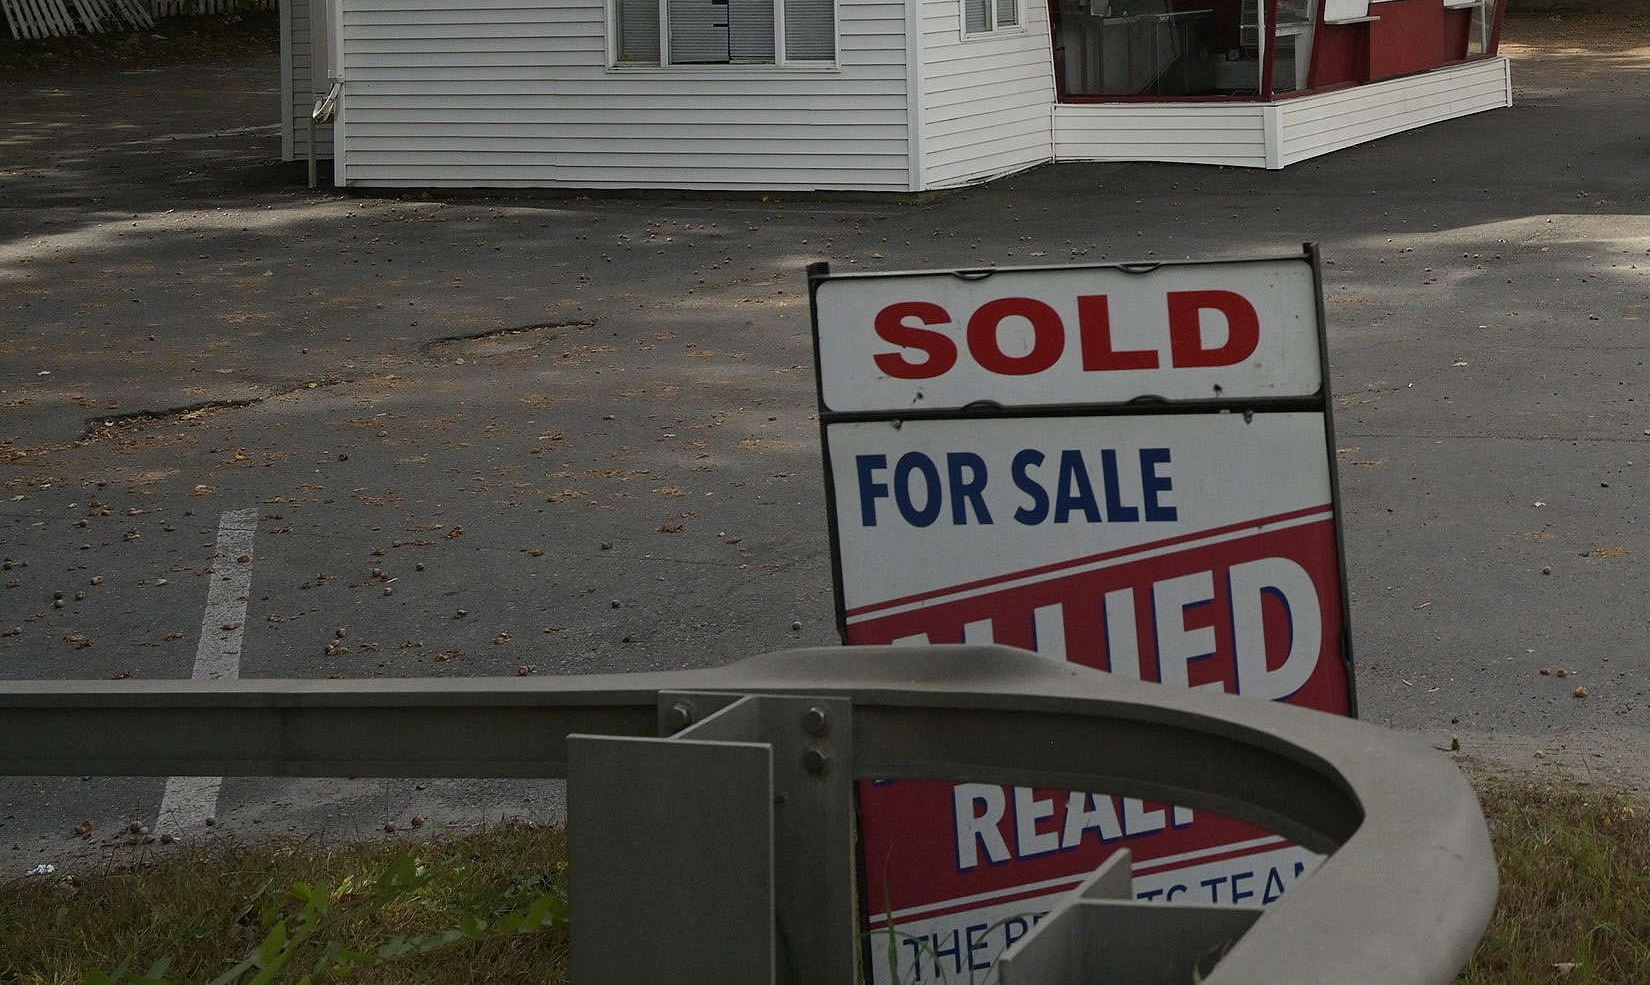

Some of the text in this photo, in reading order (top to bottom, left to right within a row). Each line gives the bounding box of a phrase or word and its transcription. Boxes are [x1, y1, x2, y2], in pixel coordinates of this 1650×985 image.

[873, 290, 1260, 380] SOLD
[855, 447, 1178, 528] FOR SALE
[902, 861, 1305, 982] THE TEA
